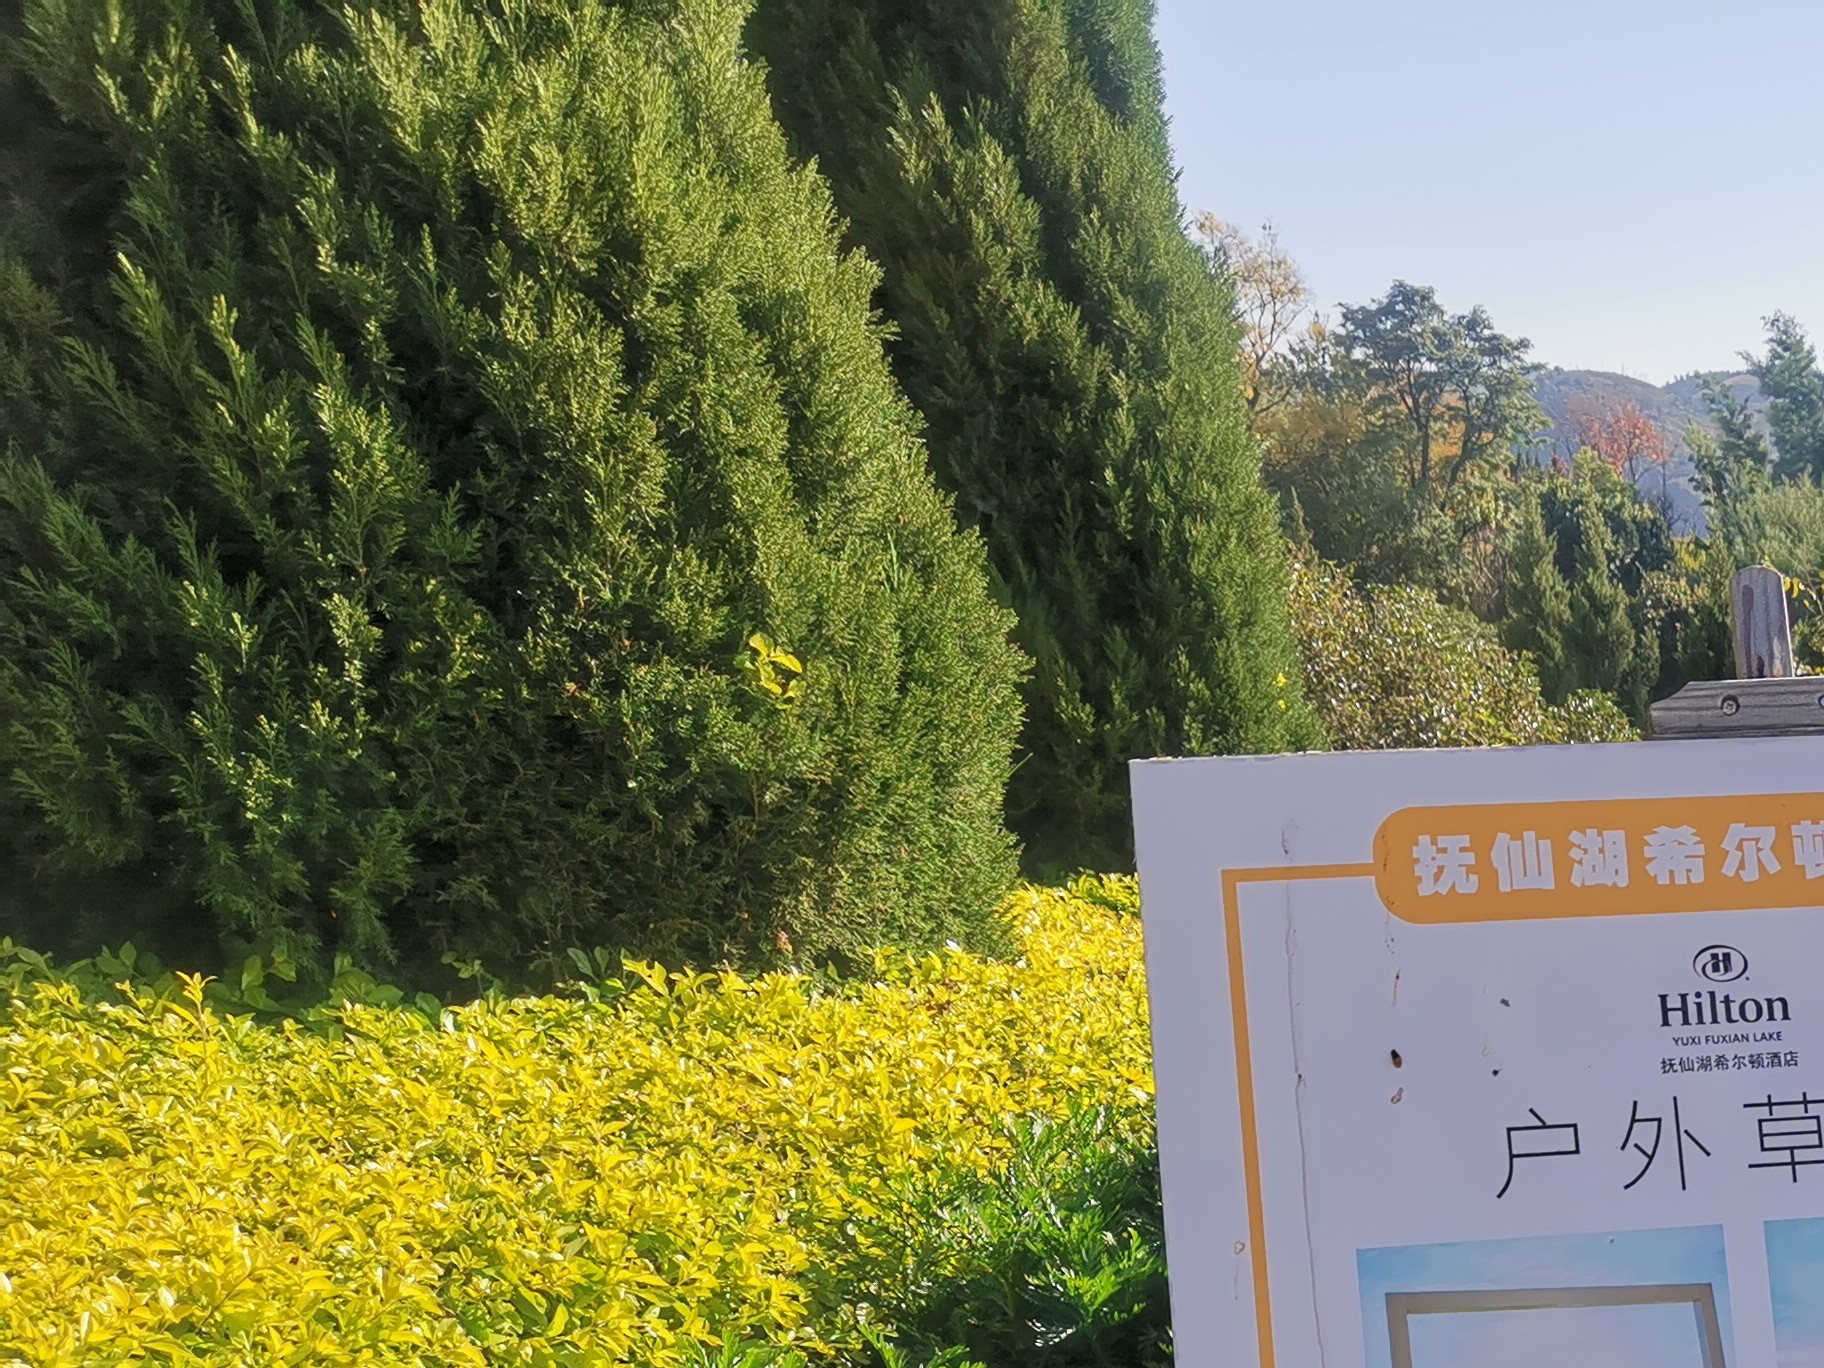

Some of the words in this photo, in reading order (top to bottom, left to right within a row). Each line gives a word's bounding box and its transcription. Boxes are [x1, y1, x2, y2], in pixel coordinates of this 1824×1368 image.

[1657, 990, 1791, 1027] Hilton
[1672, 1035, 1701, 1046] YUXI
[1705, 1033, 1750, 1045] FUXIAN
[1753, 1031, 1783, 1042] LAKE
[1660, 1051, 1799, 1074] 抚仙湖希尔顿酒店
